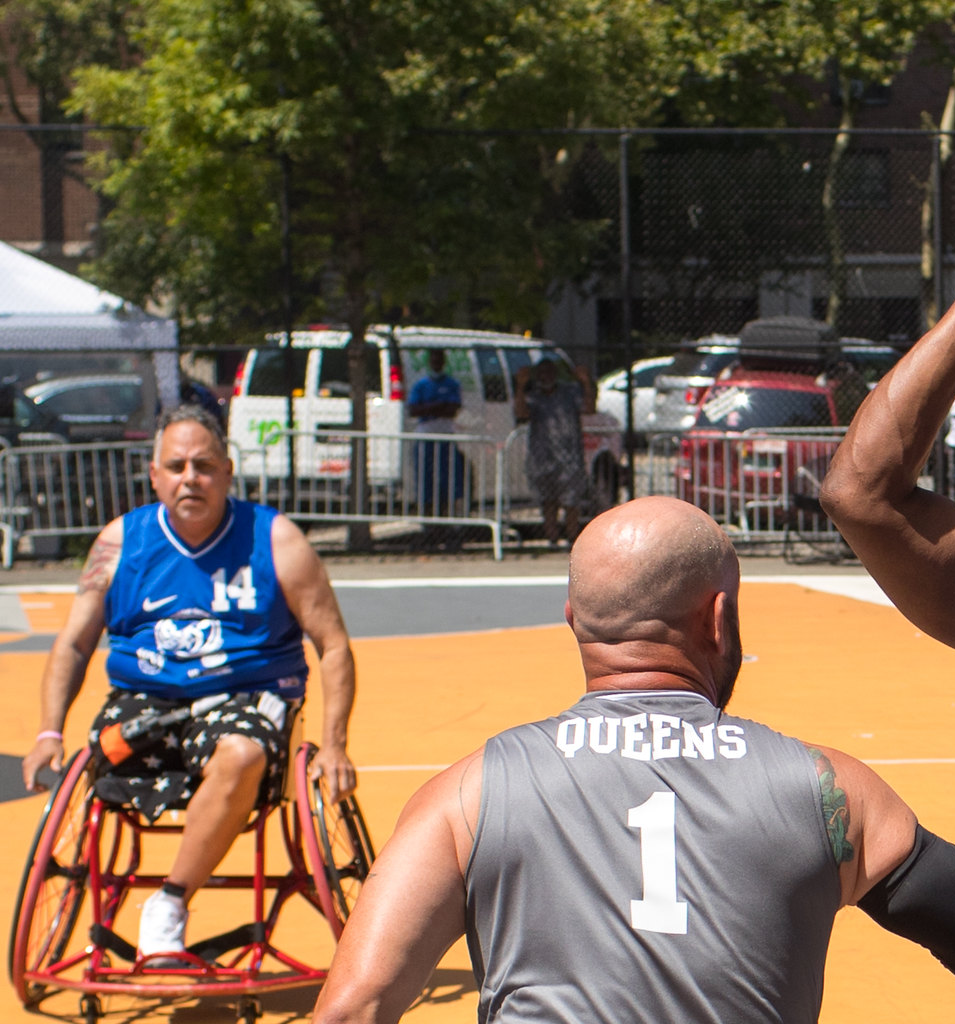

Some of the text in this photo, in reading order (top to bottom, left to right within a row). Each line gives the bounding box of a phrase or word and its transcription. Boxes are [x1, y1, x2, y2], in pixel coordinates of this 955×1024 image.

[211, 565, 257, 613] 14
[556, 712, 748, 762] QUEENS
[627, 791, 688, 935] 1
